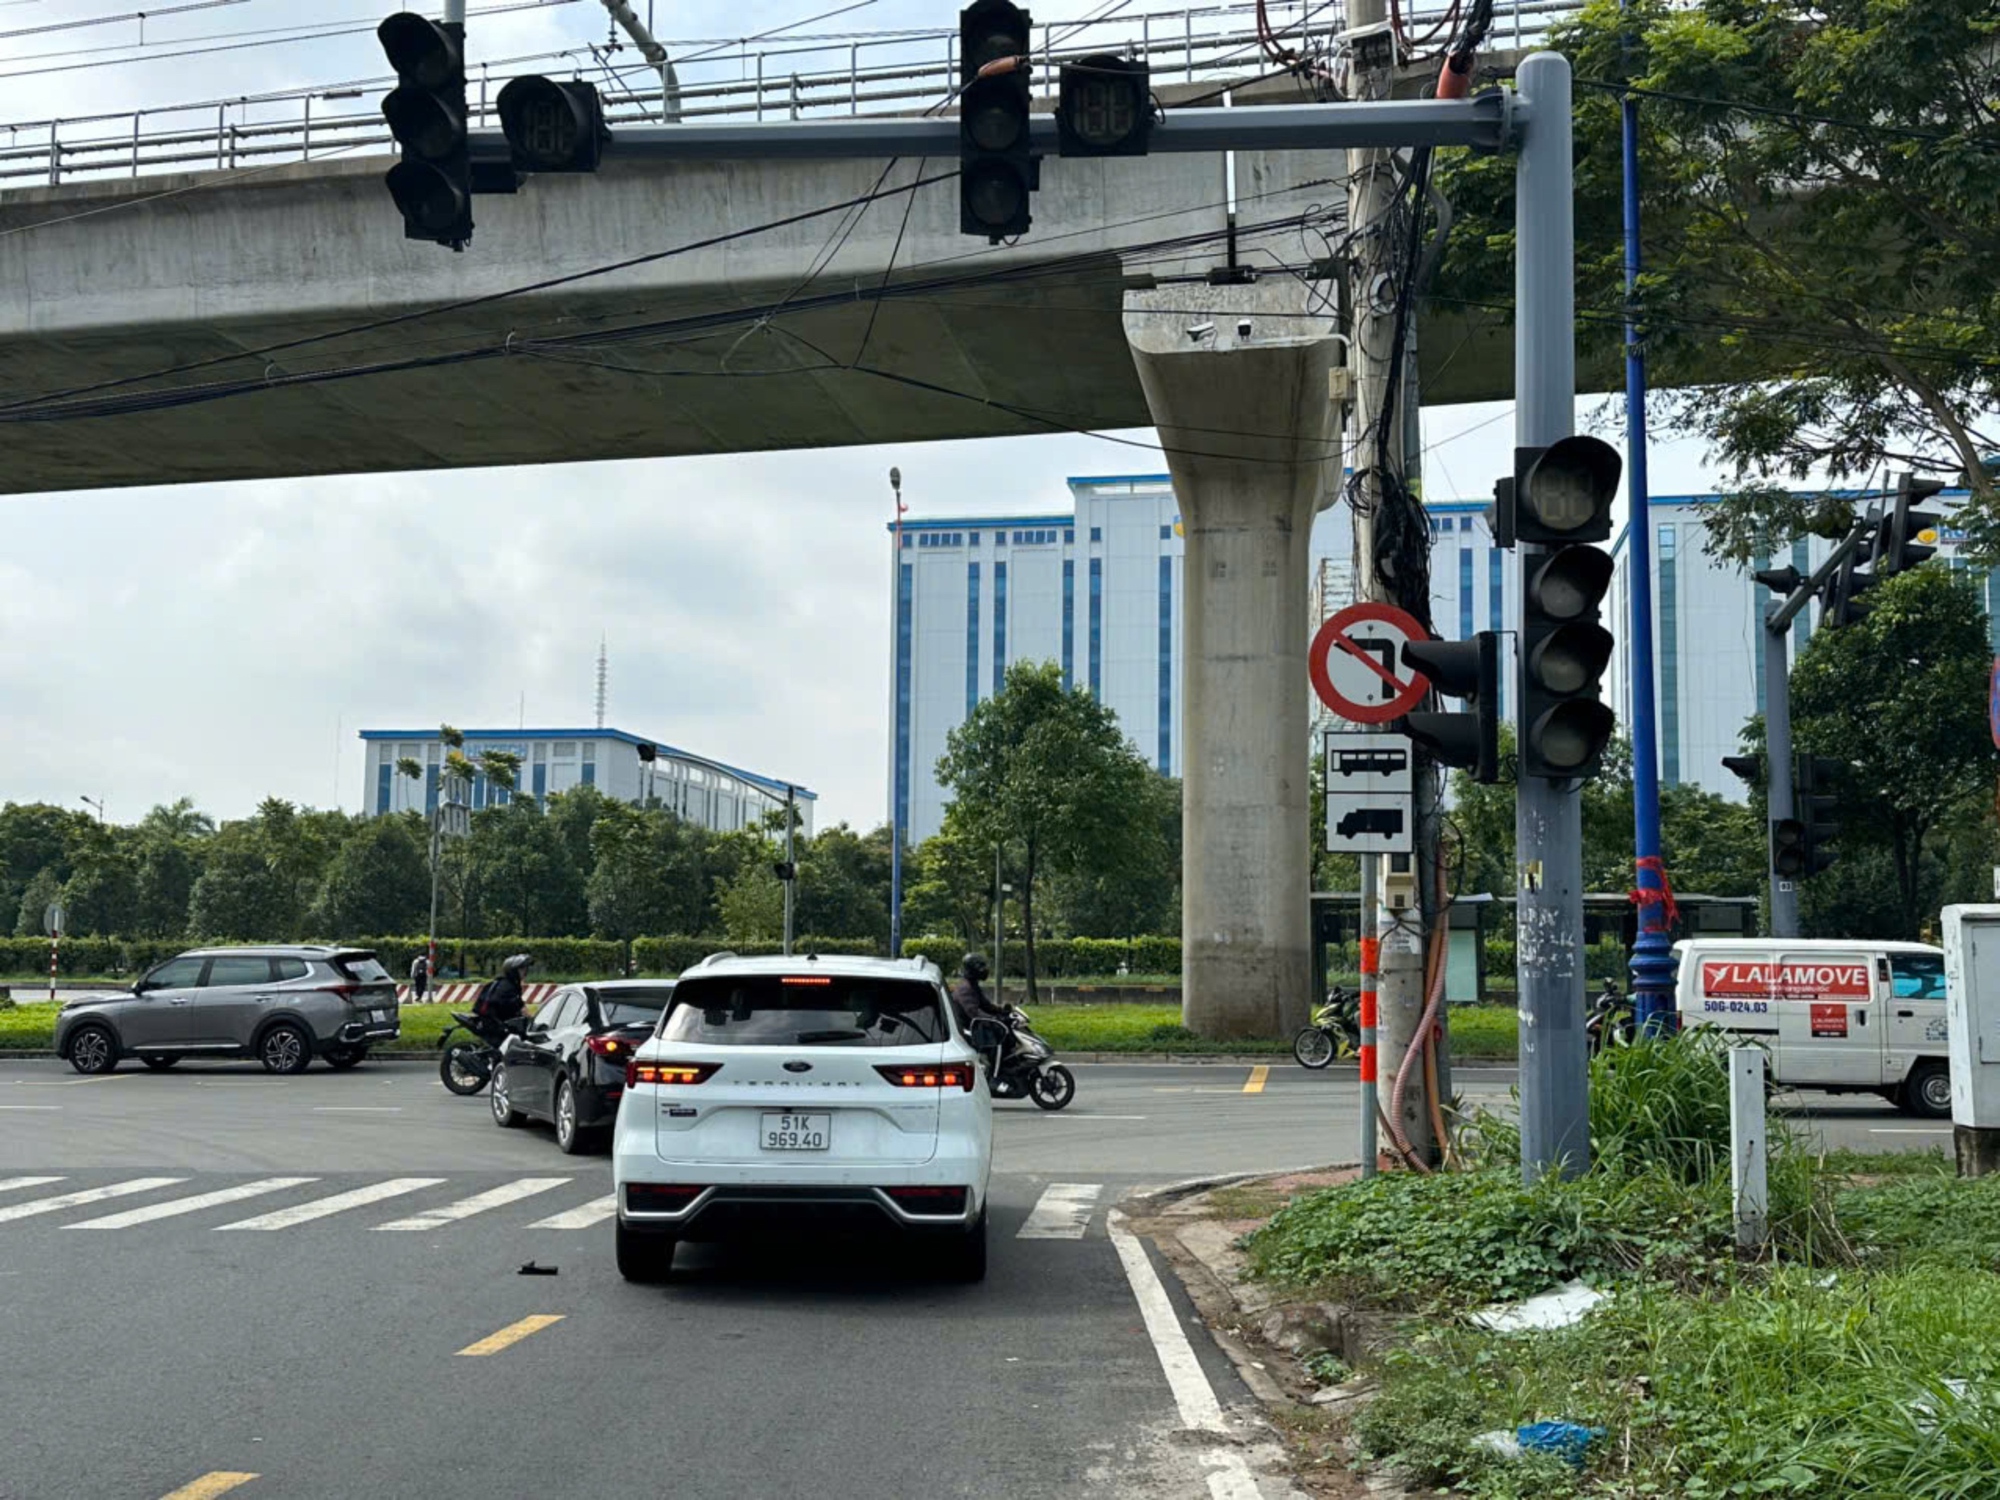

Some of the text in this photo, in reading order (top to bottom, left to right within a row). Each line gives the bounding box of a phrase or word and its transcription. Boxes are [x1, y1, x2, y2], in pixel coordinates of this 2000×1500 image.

[1732, 966, 1866, 986] LALAMOVE
[1704, 1001, 1768, 1013] 50G-024.03
[781, 1116, 810, 1131] 51K
[768, 1132, 822, 1147] 969.40
